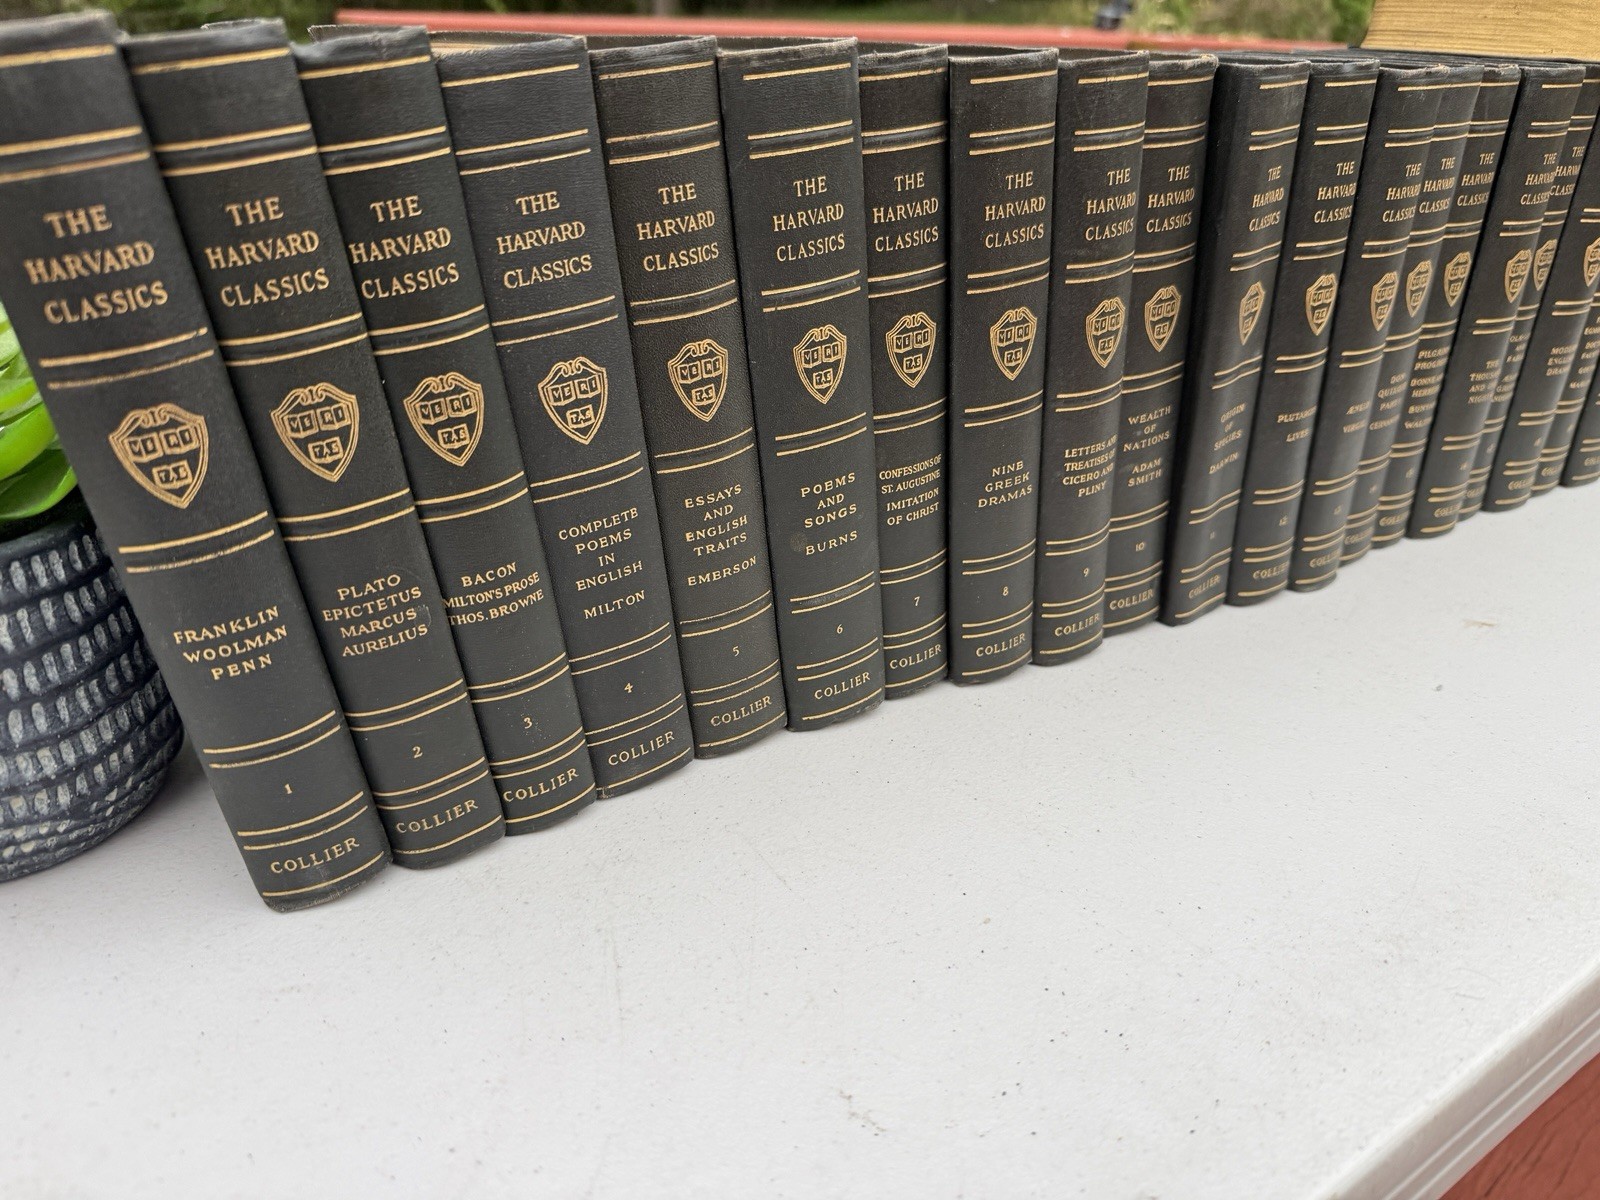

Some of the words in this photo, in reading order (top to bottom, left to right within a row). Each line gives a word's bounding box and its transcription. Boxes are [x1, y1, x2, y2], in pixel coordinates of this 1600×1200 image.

[1336, 161, 1355, 176] THE
[1405, 163, 1421, 177] THE
[1441, 157, 1456, 170] THE
[1480, 152, 1495, 165] THE
[1543, 153, 1557, 165] THE
[894, 171, 925, 192] THE
[1005, 171, 1033, 190] THE
[1107, 168, 1131, 186] THE
[1168, 165, 1191, 182] THE
[1268, 166, 1281, 181] THE
[658, 182, 697, 205] THE
[793, 176, 827, 197] THE
[1148, 188, 1195, 209] HARVARD
[226, 196, 284, 226] THE
[370, 195, 422, 223] THE
[516, 190, 560, 215] THE
[873, 198, 938, 223] HARVARD
[985, 196, 1046, 221] HARVARD
[1086, 191, 1136, 215] HARVARD
[43, 204, 112, 238] THE
[637, 210, 715, 240] HARVARD
[773, 203, 844, 232] HARVARD
[1085, 217, 1135, 241] CLASSICS
[1146, 211, 1192, 233] CLASSICS
[349, 226, 452, 264] HARVARD
[496, 221, 585, 254] HARVARD
[777, 233, 845, 262] CLASSICS
[875, 226, 938, 253] CLASSICS
[985, 223, 1044, 249] CLASSICS
[204, 230, 320, 269] HARVARD
[643, 242, 719, 272] CLASSICS
[23, 241, 155, 284] HARVARD
[503, 254, 592, 289] CLASSICS
[220, 267, 330, 307] CLASSICS
[361, 263, 459, 299] CLASSICS
[44, 281, 168, 324] CLASSICS
[1128, 405, 1171, 425] WEALTH
[1221, 402, 1246, 423] ORIGIN
[1123, 430, 1170, 452] NATIONS
[1143, 424, 1157, 435] OF
[1213, 429, 1243, 451] SPECIES
[1064, 442, 1106, 458] LETTERS
[879, 458, 934, 481] CONFESSIONS
[992, 461, 1024, 477] NINE
[1062, 470, 1100, 486] CICERO
[1101, 462, 1114, 477] AND
[1064, 454, 1108, 472] TREATISES
[1132, 457, 1162, 474] ADAM
[1208, 452, 1239, 475] DARWIN
[800, 472, 856, 498] POEMS
[881, 484, 894, 495] ST.
[896, 469, 941, 492] AUGUSTINE
[985, 472, 1030, 493] GREEK
[1078, 480, 1107, 498] PLINY
[1127, 468, 1162, 487] SMITH
[684, 483, 742, 509] ESSAYS
[817, 493, 845, 510] AND
[886, 487, 940, 512] IMITATION
[978, 485, 1033, 508] DRAMAS
[558, 507, 640, 541] COMPLETE
[704, 504, 734, 522] AND
[804, 504, 858, 529] SONGS
[886, 515, 903, 526] OF
[906, 502, 940, 522] CHRIST
[685, 514, 748, 543] ENGLISH
[575, 528, 633, 555] POEMS
[693, 532, 747, 557] TRAITS
[806, 530, 858, 556] BURNS
[1135, 542, 1145, 552] 10
[598, 553, 616, 568] IN
[687, 555, 757, 587] EMERSON
[1083, 567, 1090, 578] 9
[336, 574, 401, 601] PLATO
[461, 562, 518, 588] BACON
[576, 560, 644, 592] ENGLISH
[1188, 574, 1221, 599] COLLIER
[442, 588, 503, 609] MILTON'S
[504, 571, 540, 596] PROSE
[914, 596, 921, 607] 7
[1003, 586, 1009, 597] 8
[1109, 588, 1154, 611] COLLIER
[322, 586, 422, 622] EPICTETUS
[448, 611, 489, 626] THOS.
[489, 589, 544, 620] BROWNE
[584, 589, 646, 620] MILTON
[172, 605, 279, 645] FRANKLIN
[340, 609, 417, 639] MARCUS
[836, 624, 844, 635] 6
[1054, 612, 1100, 637] COLLIER
[182, 625, 288, 664] WOOLMAN
[342, 624, 428, 657] AURELIUS
[733, 645, 740, 657] 5
[976, 632, 1026, 657] COLLIER
[211, 654, 272, 680] PENN
[889, 644, 942, 670] COLLIER
[624, 682, 634, 694] 4
[815, 671, 871, 700] COLLIER
[523, 716, 533, 729] 3
[711, 695, 772, 727] COLLIER
[412, 746, 423, 759] 2
[608, 730, 676, 767] COLLIER
[284, 784, 292, 795] 1
[503, 768, 579, 803] COLLIER
[396, 799, 479, 834] COLLIER
[270, 837, 360, 874] COLLIER
